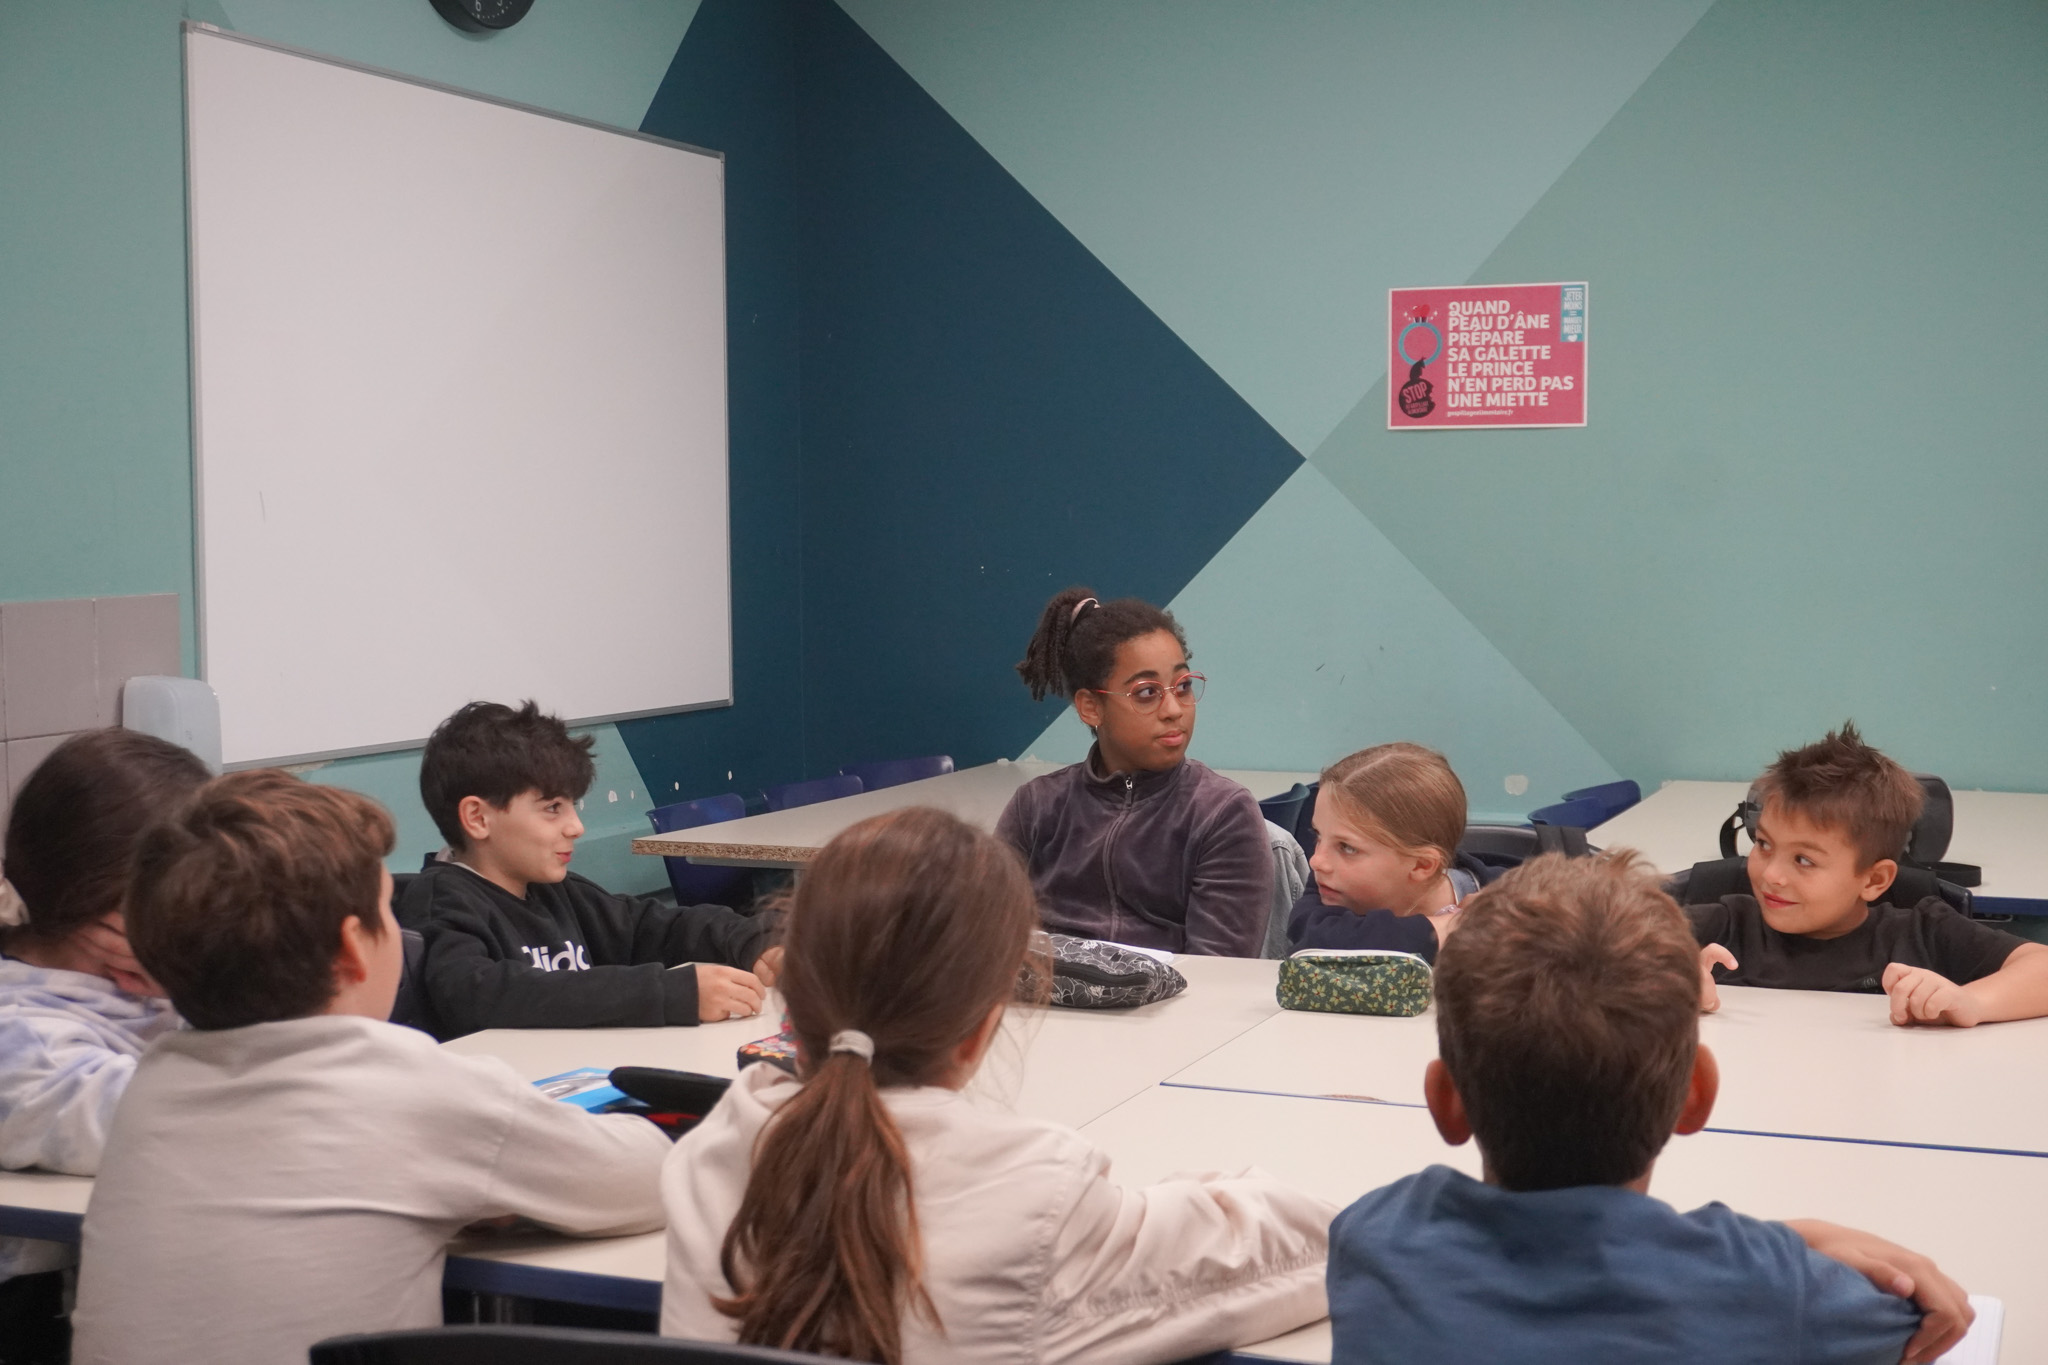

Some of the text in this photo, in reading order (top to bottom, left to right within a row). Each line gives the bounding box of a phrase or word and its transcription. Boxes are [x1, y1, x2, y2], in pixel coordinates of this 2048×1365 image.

[1564, 291, 1583, 301] JETER
[1448, 300, 1510, 317] QUAND
[1448, 310, 1550, 331] PEAU D'ÂNE
[1448, 327, 1524, 346] PRÉPARE
[1448, 345, 1551, 361] SA GALETTE
[1447, 361, 1534, 377] LE PRINCE
[1447, 376, 1574, 392] N'EN PERD PAS
[1402, 381, 1427, 404] STOP
[1447, 392, 1549, 407] UNE MIETTE
